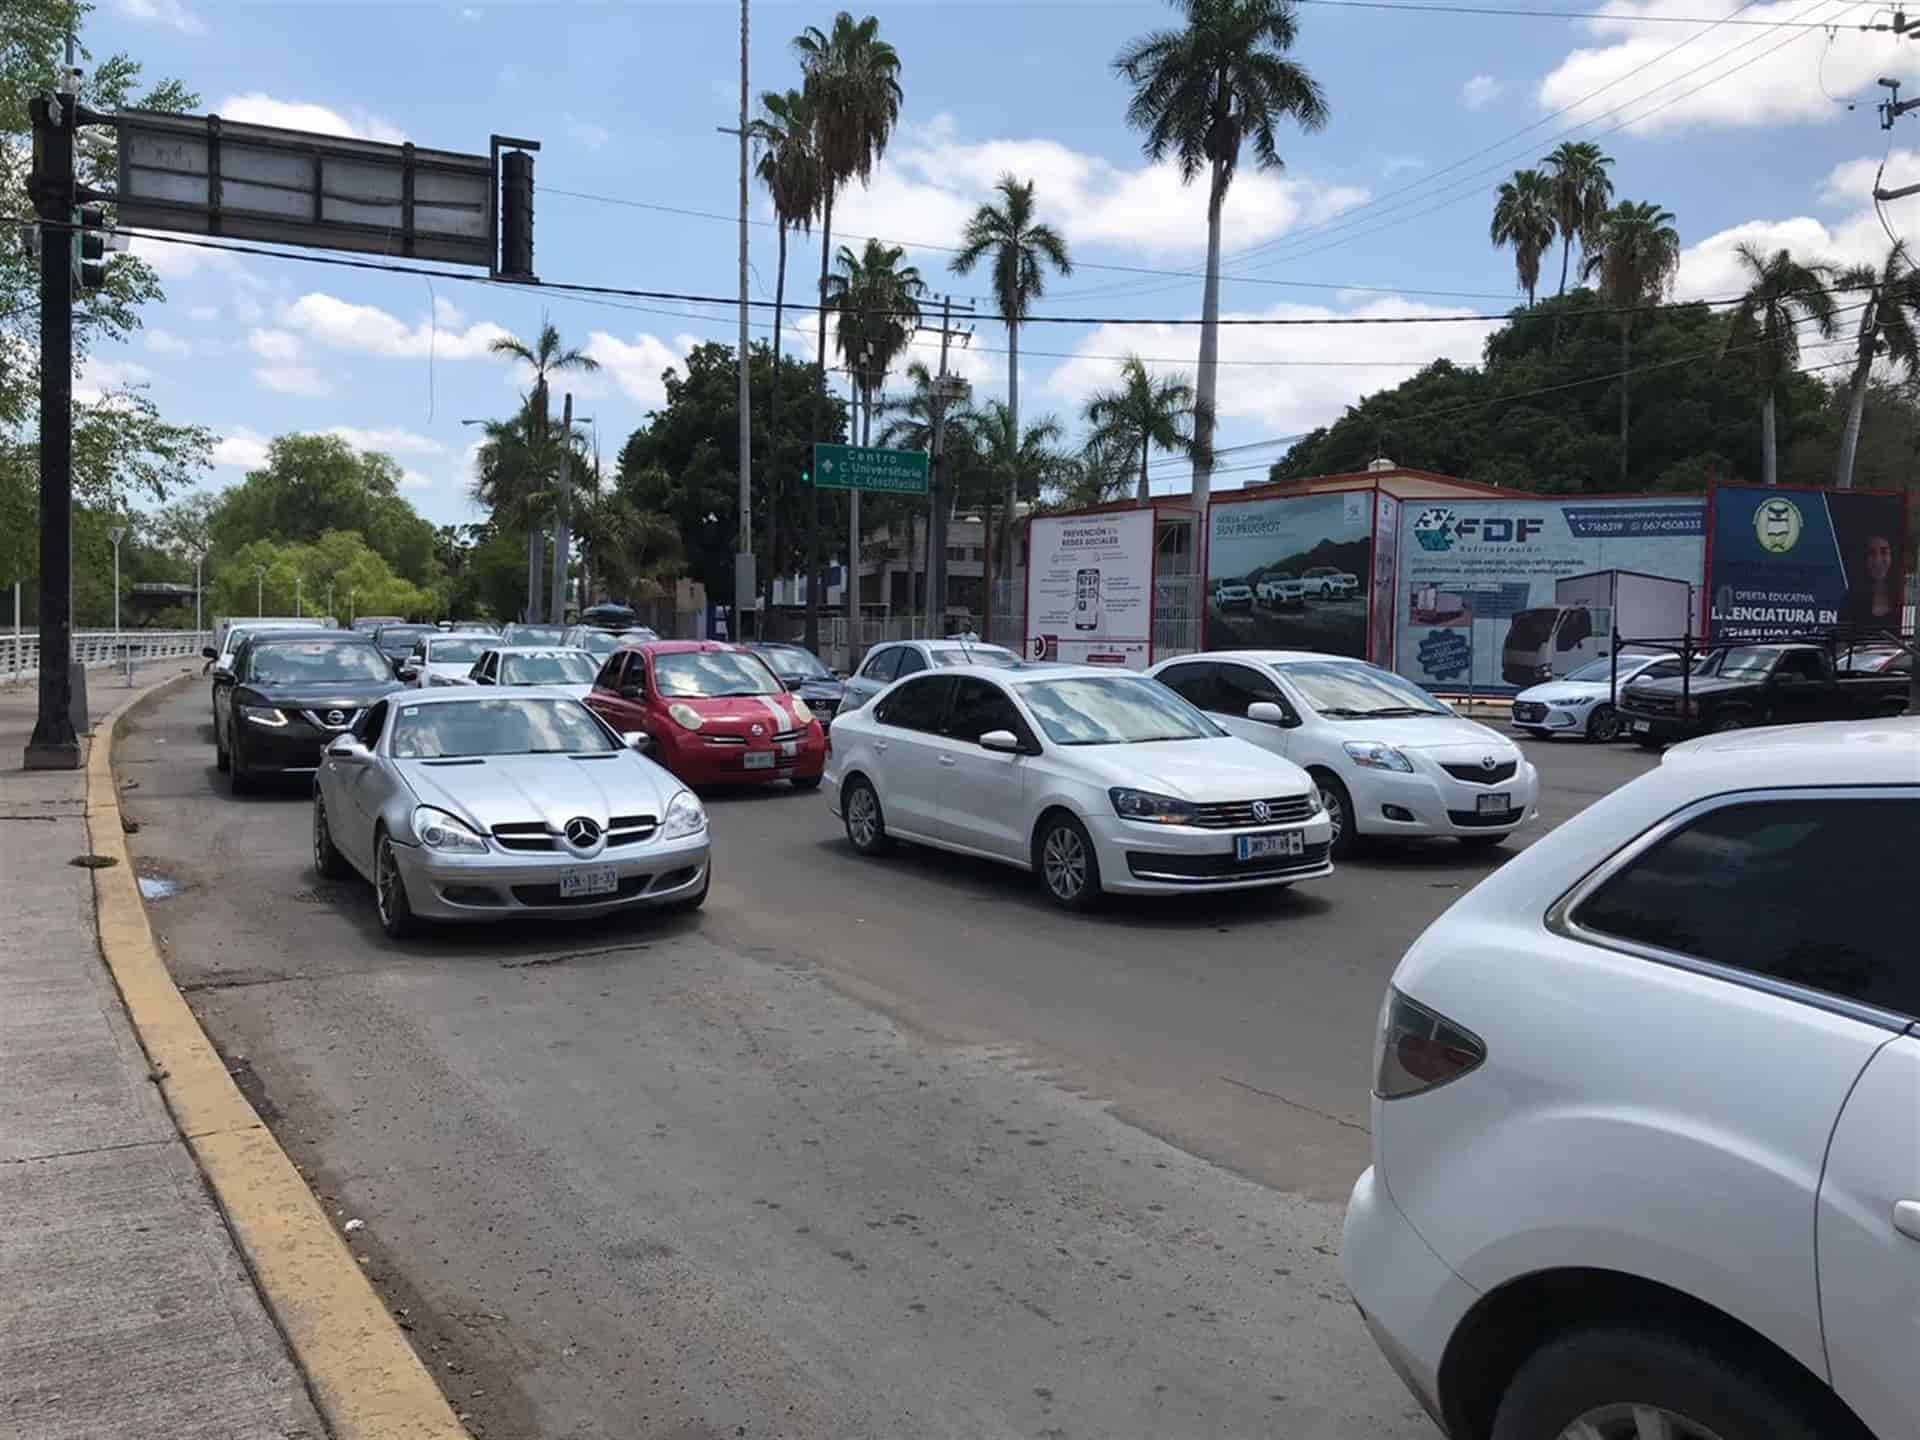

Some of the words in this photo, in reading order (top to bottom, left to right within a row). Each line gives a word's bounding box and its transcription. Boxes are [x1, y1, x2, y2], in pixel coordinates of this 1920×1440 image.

[848, 450, 897, 464] Centro
[1735, 591, 1766, 602] OFERTA
[1818, 610, 1838, 624] EN
